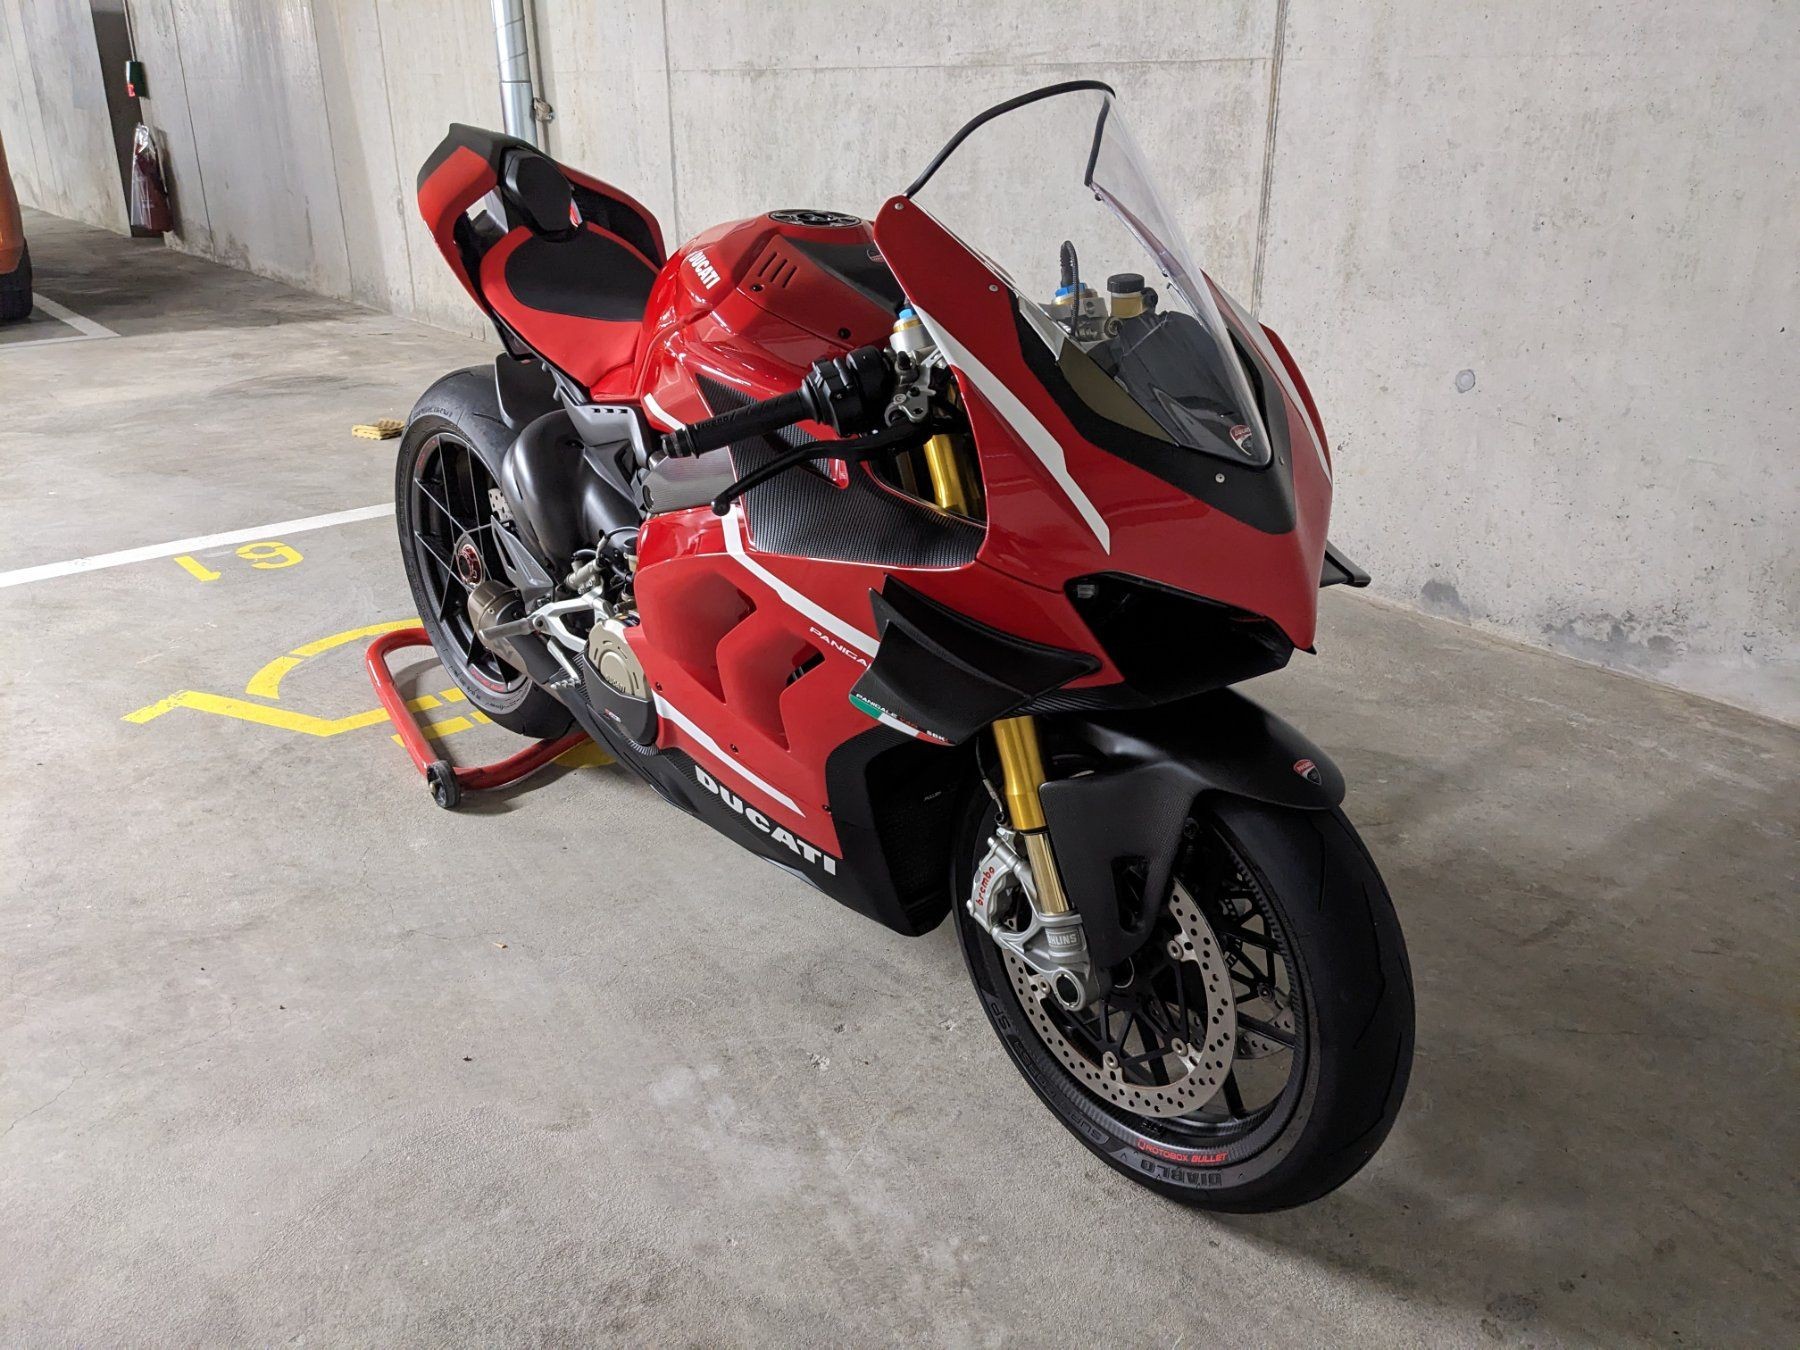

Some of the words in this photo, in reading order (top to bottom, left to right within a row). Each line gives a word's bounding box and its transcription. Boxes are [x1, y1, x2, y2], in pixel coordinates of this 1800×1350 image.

[809, 626, 872, 670] PANIGA
[855, 693, 898, 719] PANIGALE
[695, 765, 836, 876] DUCATI
[975, 866, 996, 906] brembo
[1140, 1159, 1222, 1186] DIABLO
[1191, 1151, 1229, 1163] BULLET
